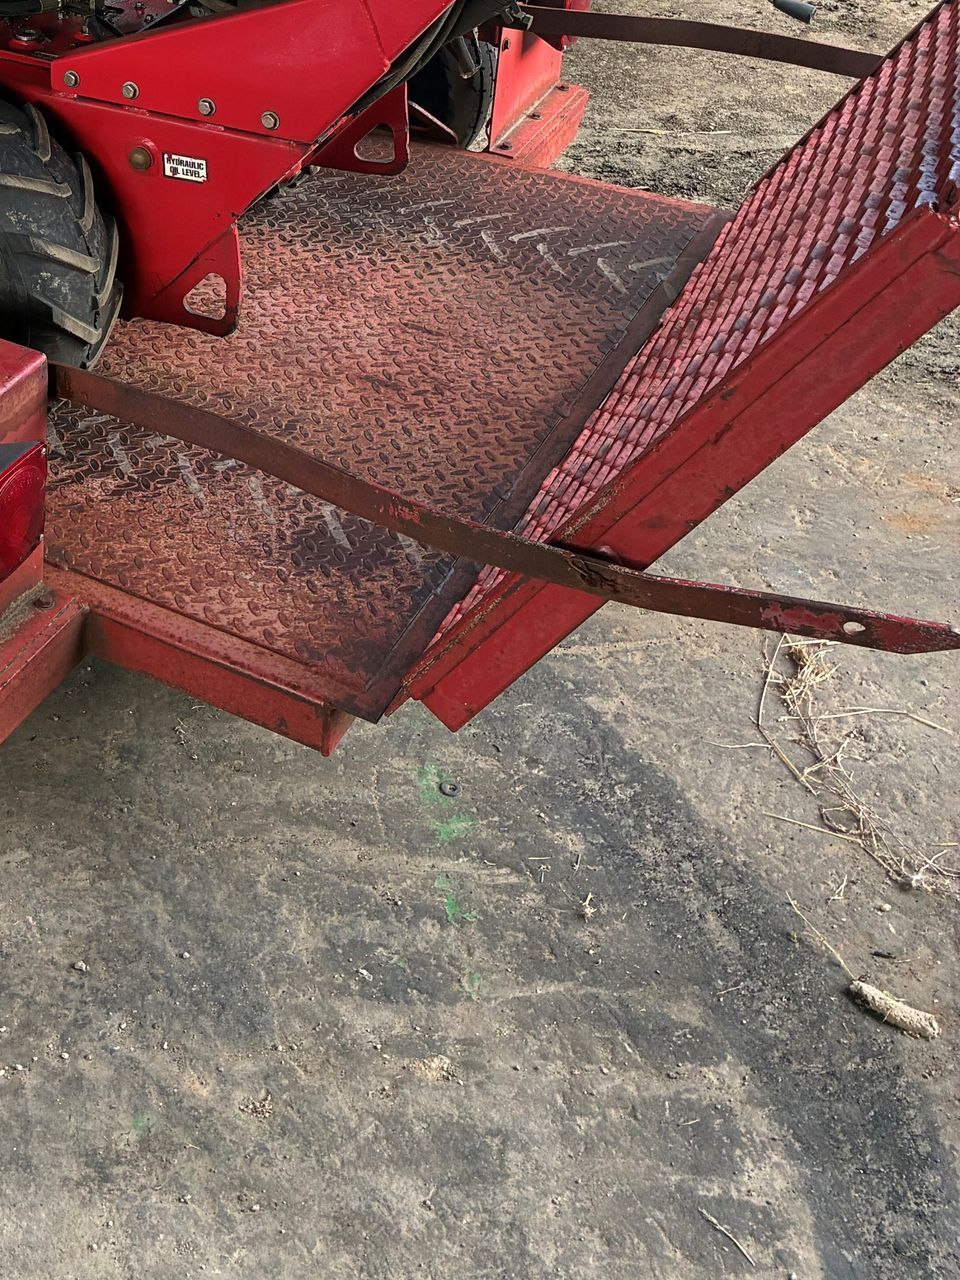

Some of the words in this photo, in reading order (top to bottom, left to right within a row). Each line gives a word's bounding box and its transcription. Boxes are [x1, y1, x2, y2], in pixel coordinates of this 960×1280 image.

[166, 157, 204, 170] HYDRAULIC
[169, 166, 181, 176] OIL
[182, 168, 202, 178] LEVEL
